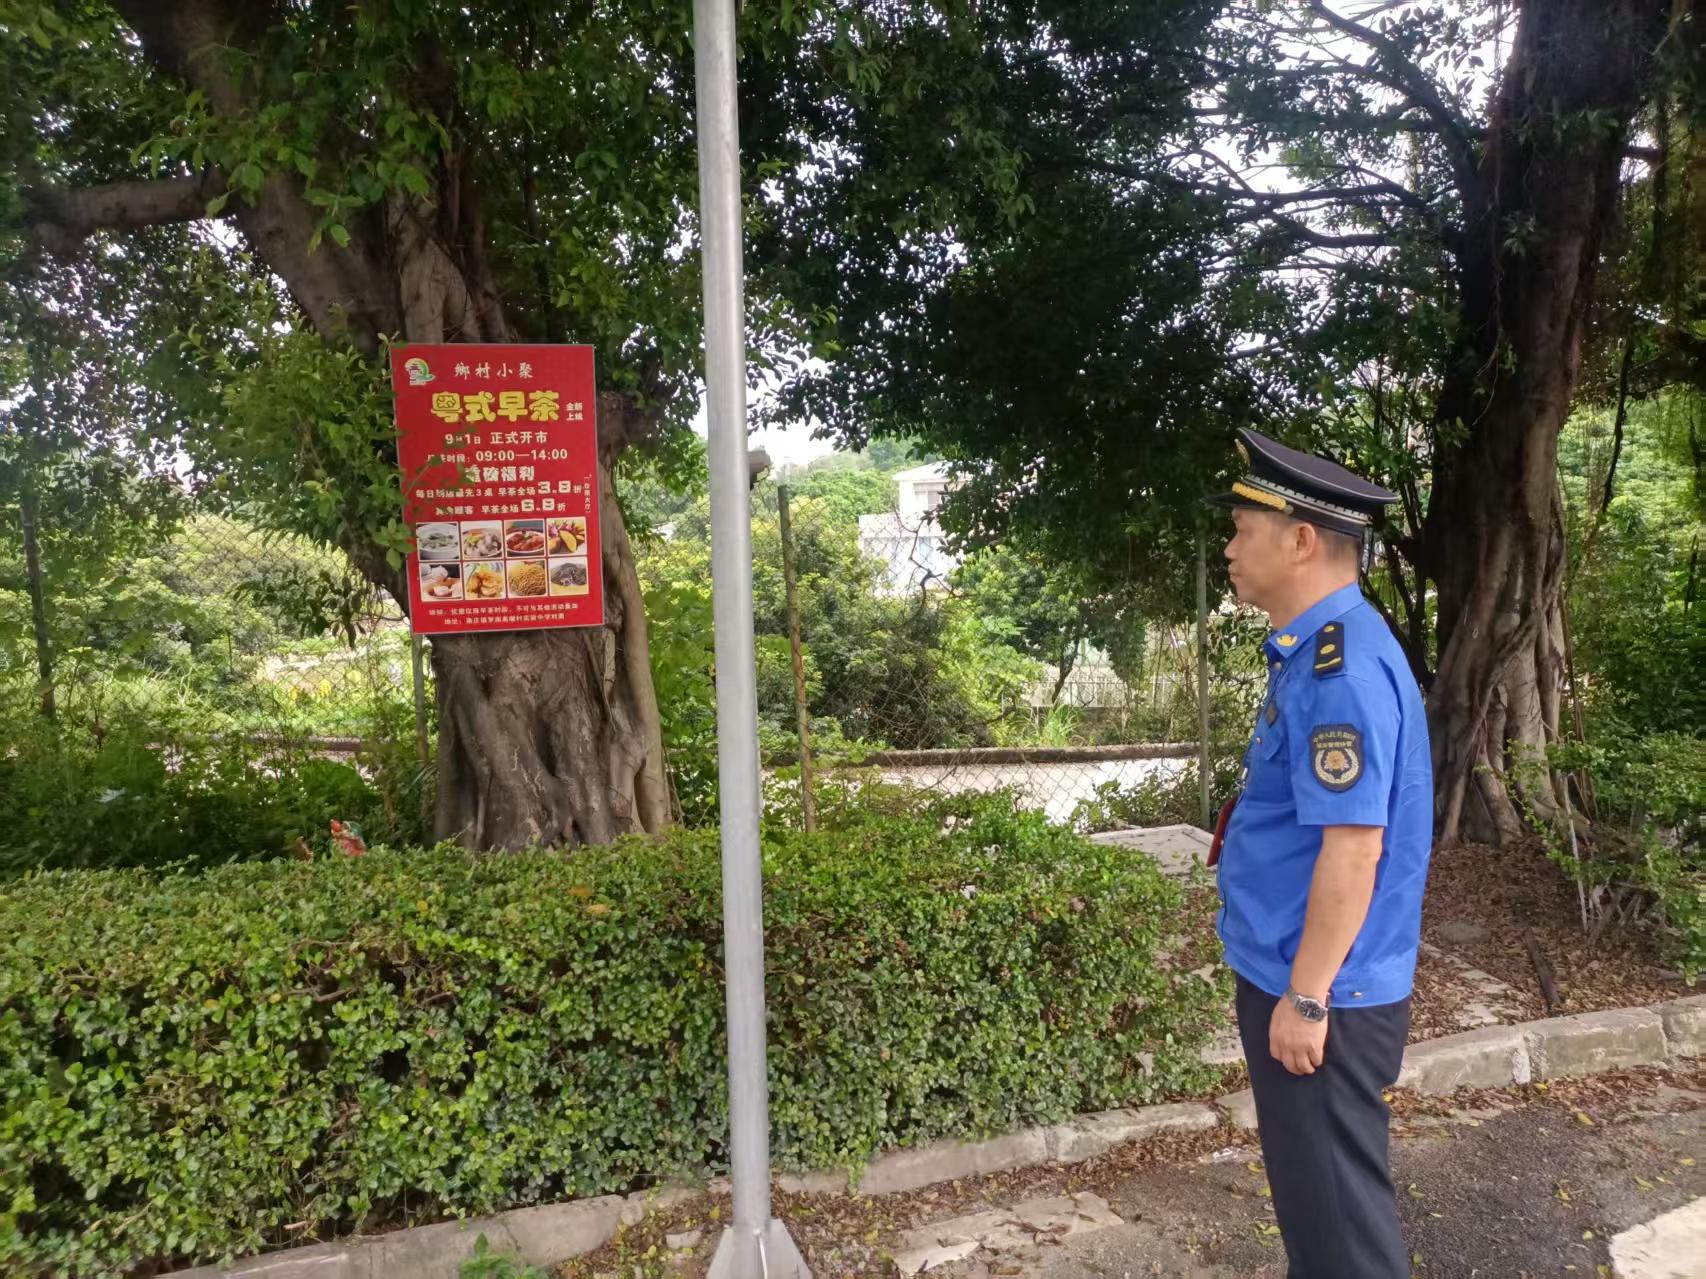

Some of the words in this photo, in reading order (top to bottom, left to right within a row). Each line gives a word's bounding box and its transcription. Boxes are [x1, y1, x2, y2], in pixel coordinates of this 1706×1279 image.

[431, 391, 560, 423] 粤式早茶
[490, 431, 548, 445] 正式开市
